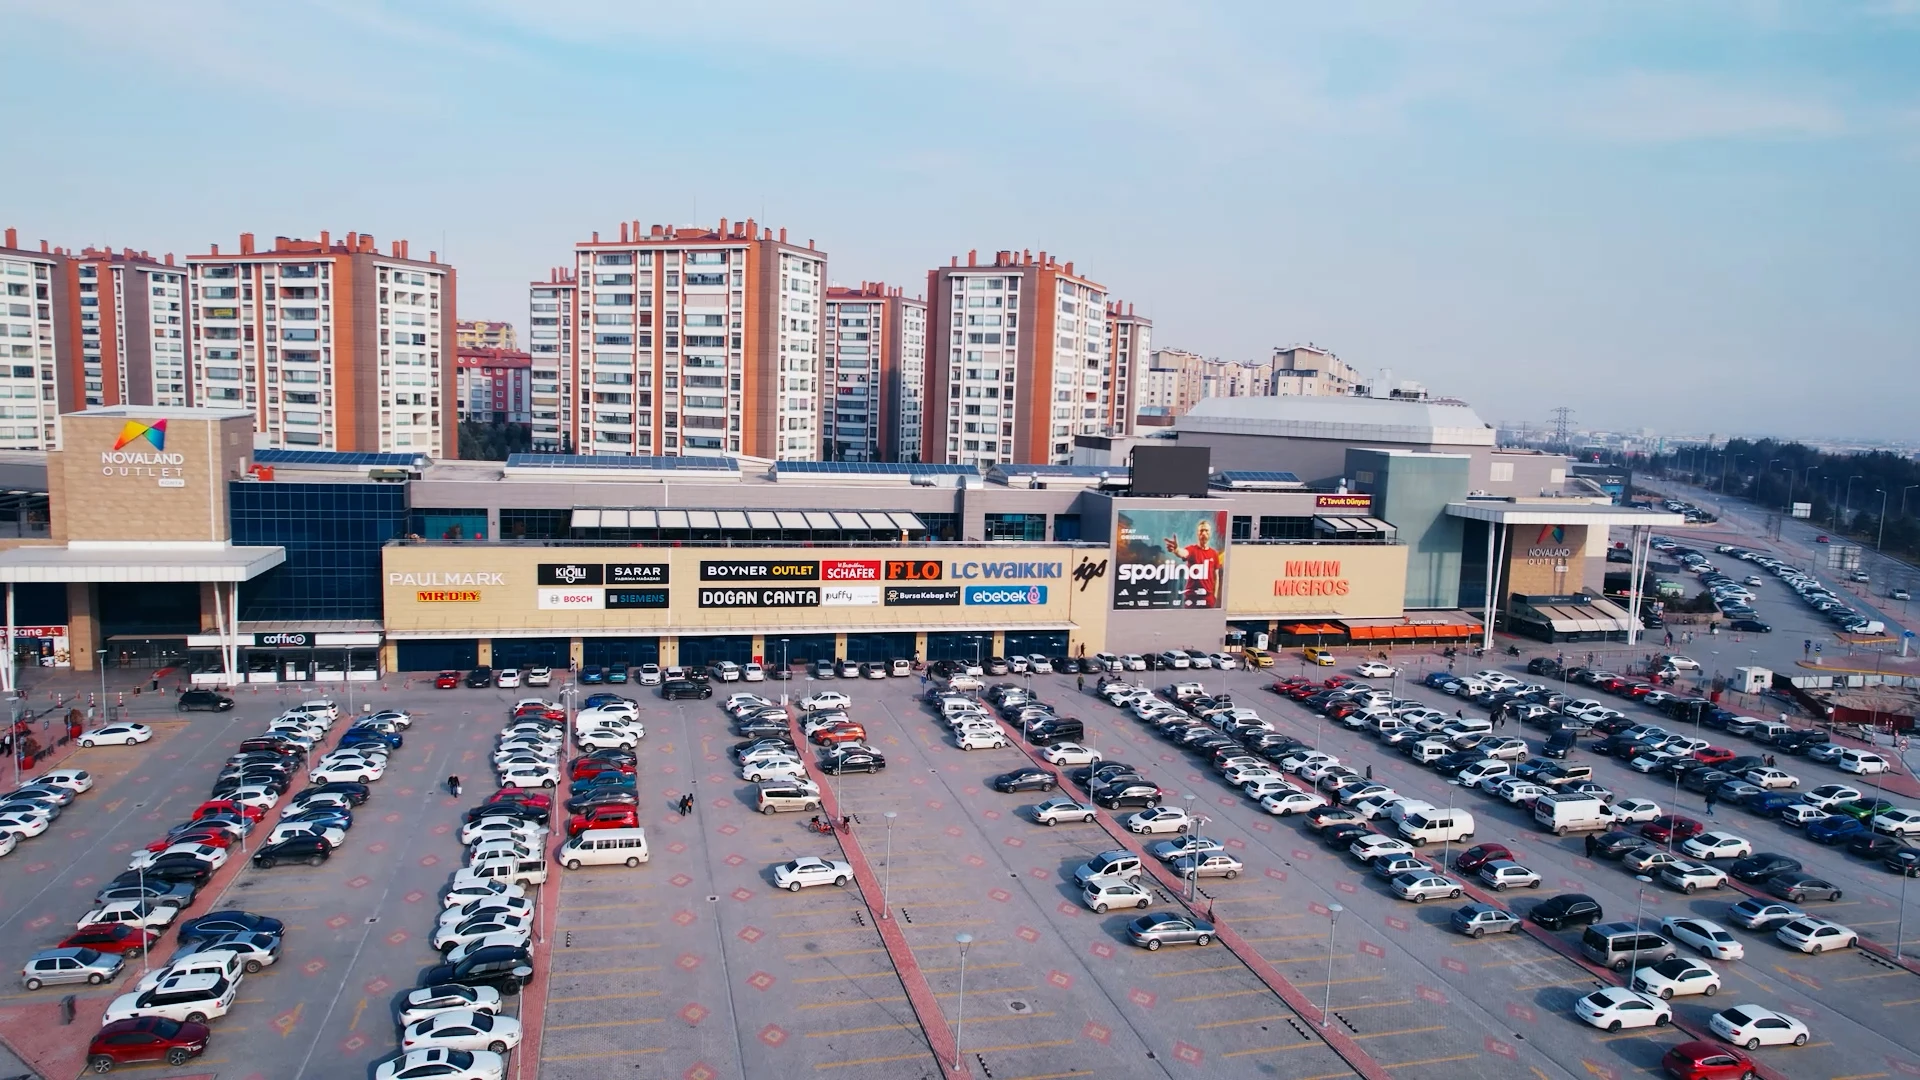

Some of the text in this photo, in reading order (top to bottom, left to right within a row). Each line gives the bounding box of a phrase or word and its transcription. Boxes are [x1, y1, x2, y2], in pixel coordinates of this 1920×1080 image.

[101, 452, 184, 464] NOVALAND
[102, 466, 183, 477] OUTLET
[1528, 548, 1571, 557] NOVALAND
[1528, 558, 1569, 566] OUTLET
[614, 567, 661, 576] SARAR
[707, 565, 814, 576] BOYNER OUTLET
[827, 568, 876, 579] SCHAFER
[888, 561, 940, 579] FLO
[951, 562, 979, 579] LC
[1118, 559, 1209, 585] sporjinal
[389, 572, 505, 586] PAULMARK
[619, 594, 665, 603] SIEMENS
[702, 590, 758, 605] DOĞAN
[825, 591, 853, 602] puffy
[920, 592, 944, 600] Kebap
